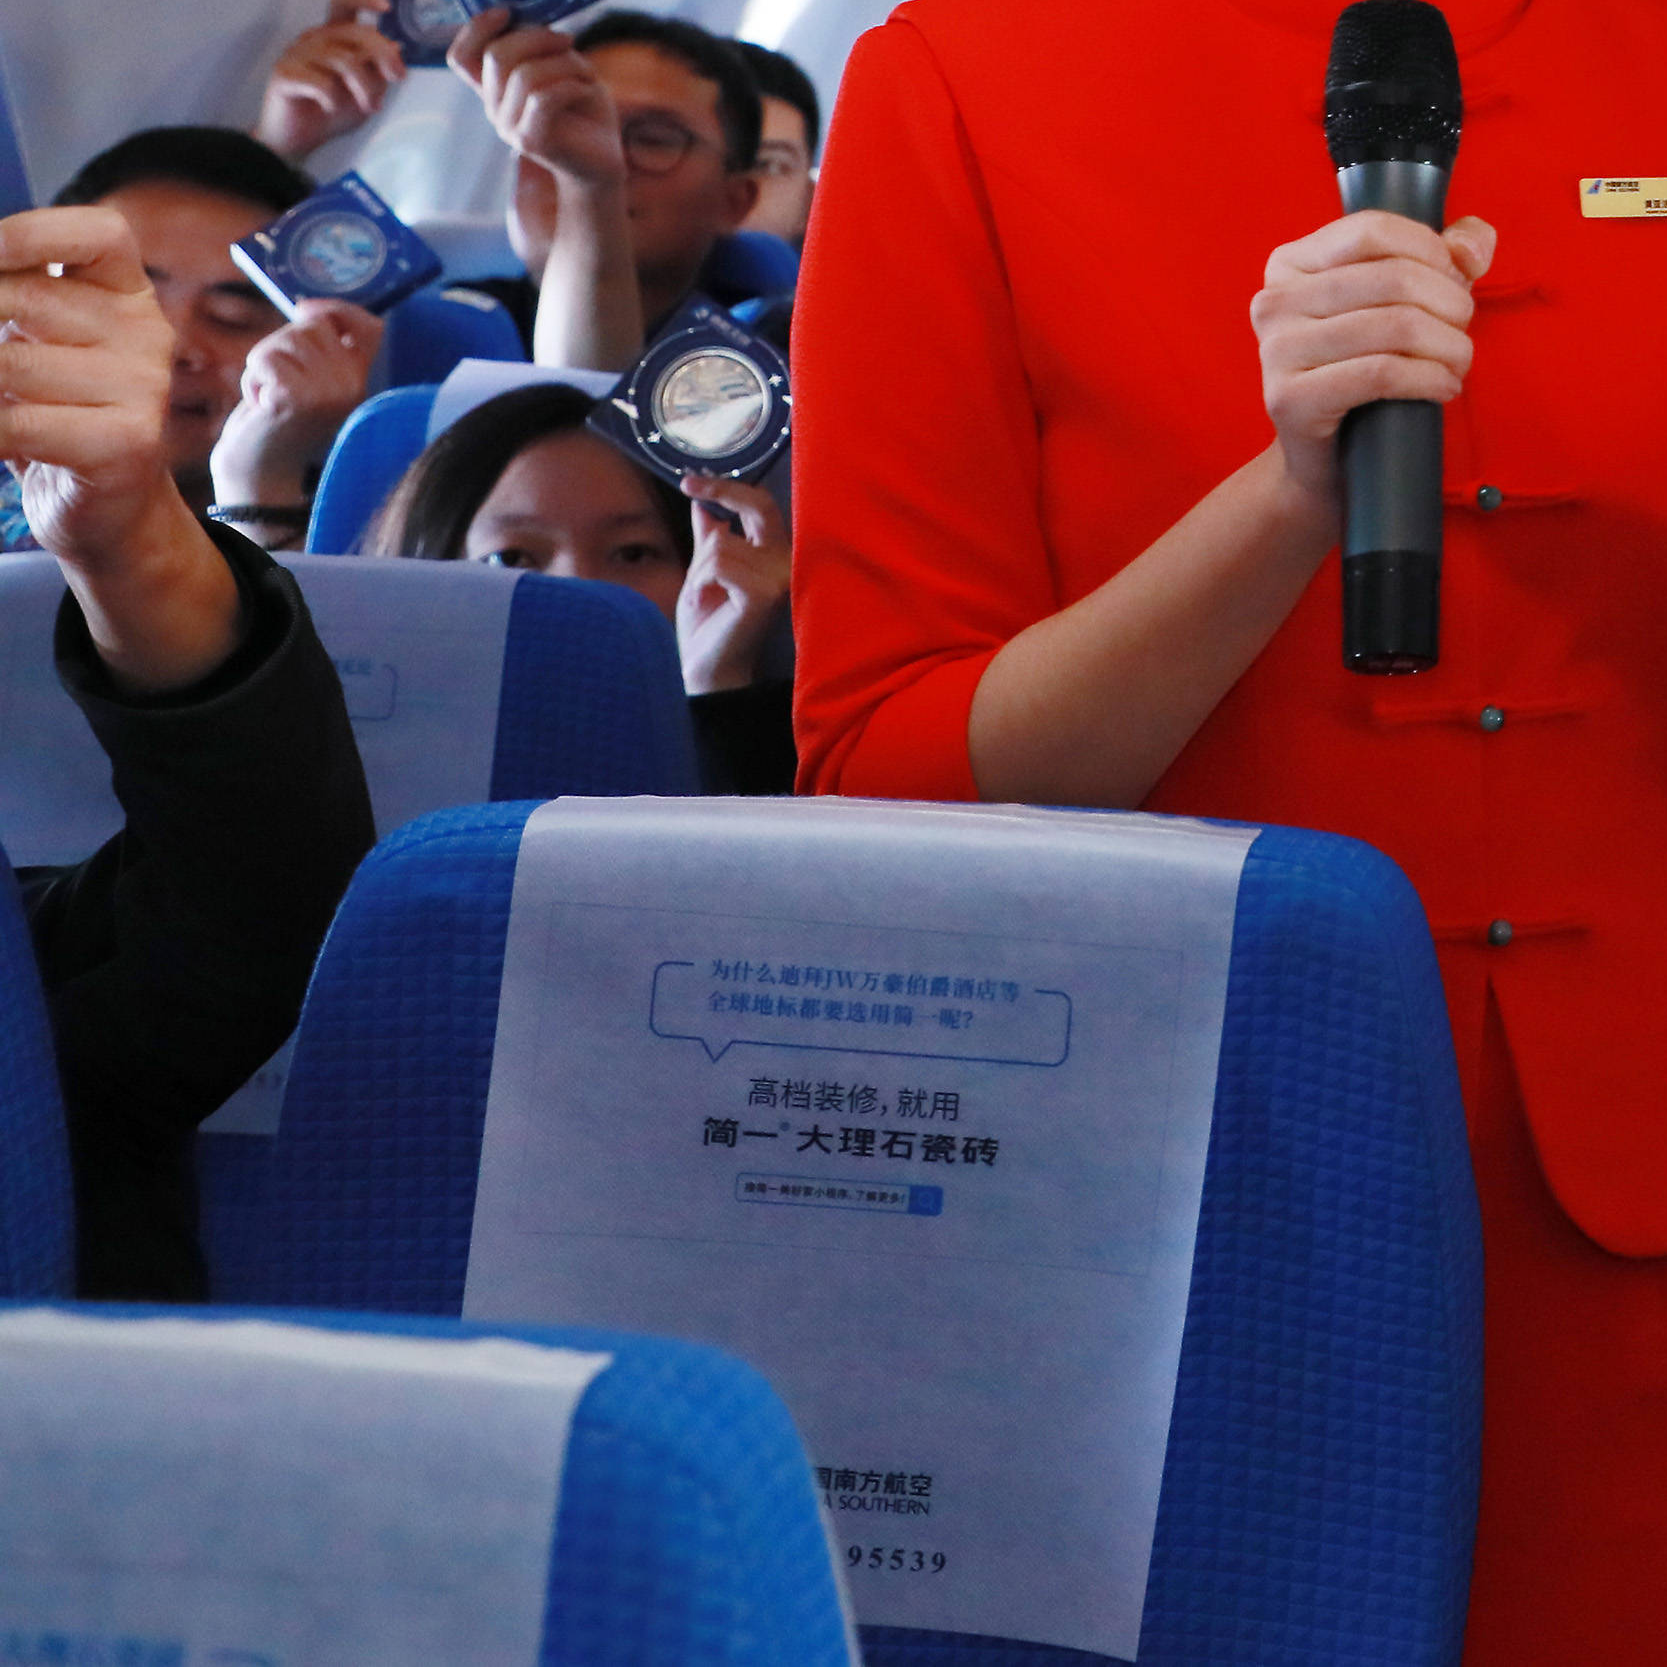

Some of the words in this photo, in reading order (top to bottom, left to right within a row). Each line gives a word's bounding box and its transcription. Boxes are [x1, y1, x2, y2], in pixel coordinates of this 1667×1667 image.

[748, 1076, 961, 1121] 高档装修，就用
[838, 1494, 931, 1516] SOUTHERN
[847, 1544, 948, 1574] 95539
